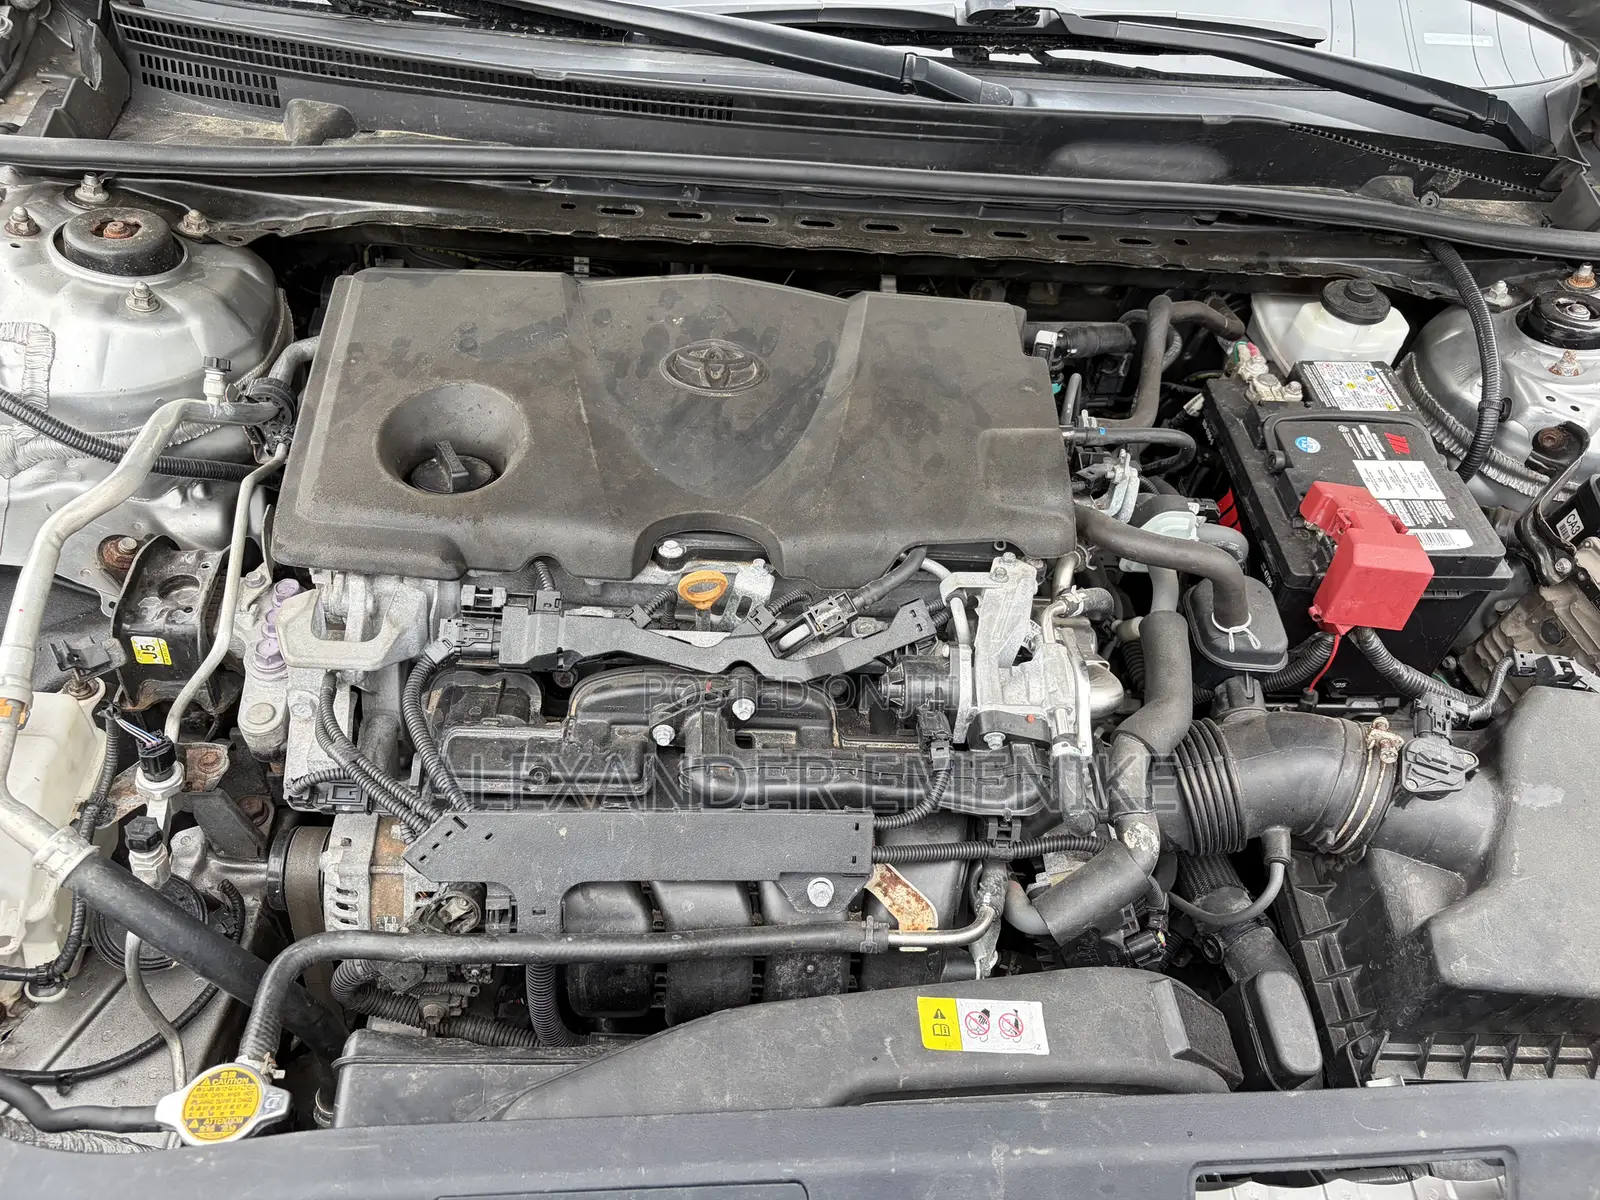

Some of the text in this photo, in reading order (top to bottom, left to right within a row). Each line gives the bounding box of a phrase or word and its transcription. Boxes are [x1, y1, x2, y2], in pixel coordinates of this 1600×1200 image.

[1566, 513, 1581, 536] CA3
[140, 644, 158, 659] J5
[203, 1116, 243, 1125] ATTENTION
